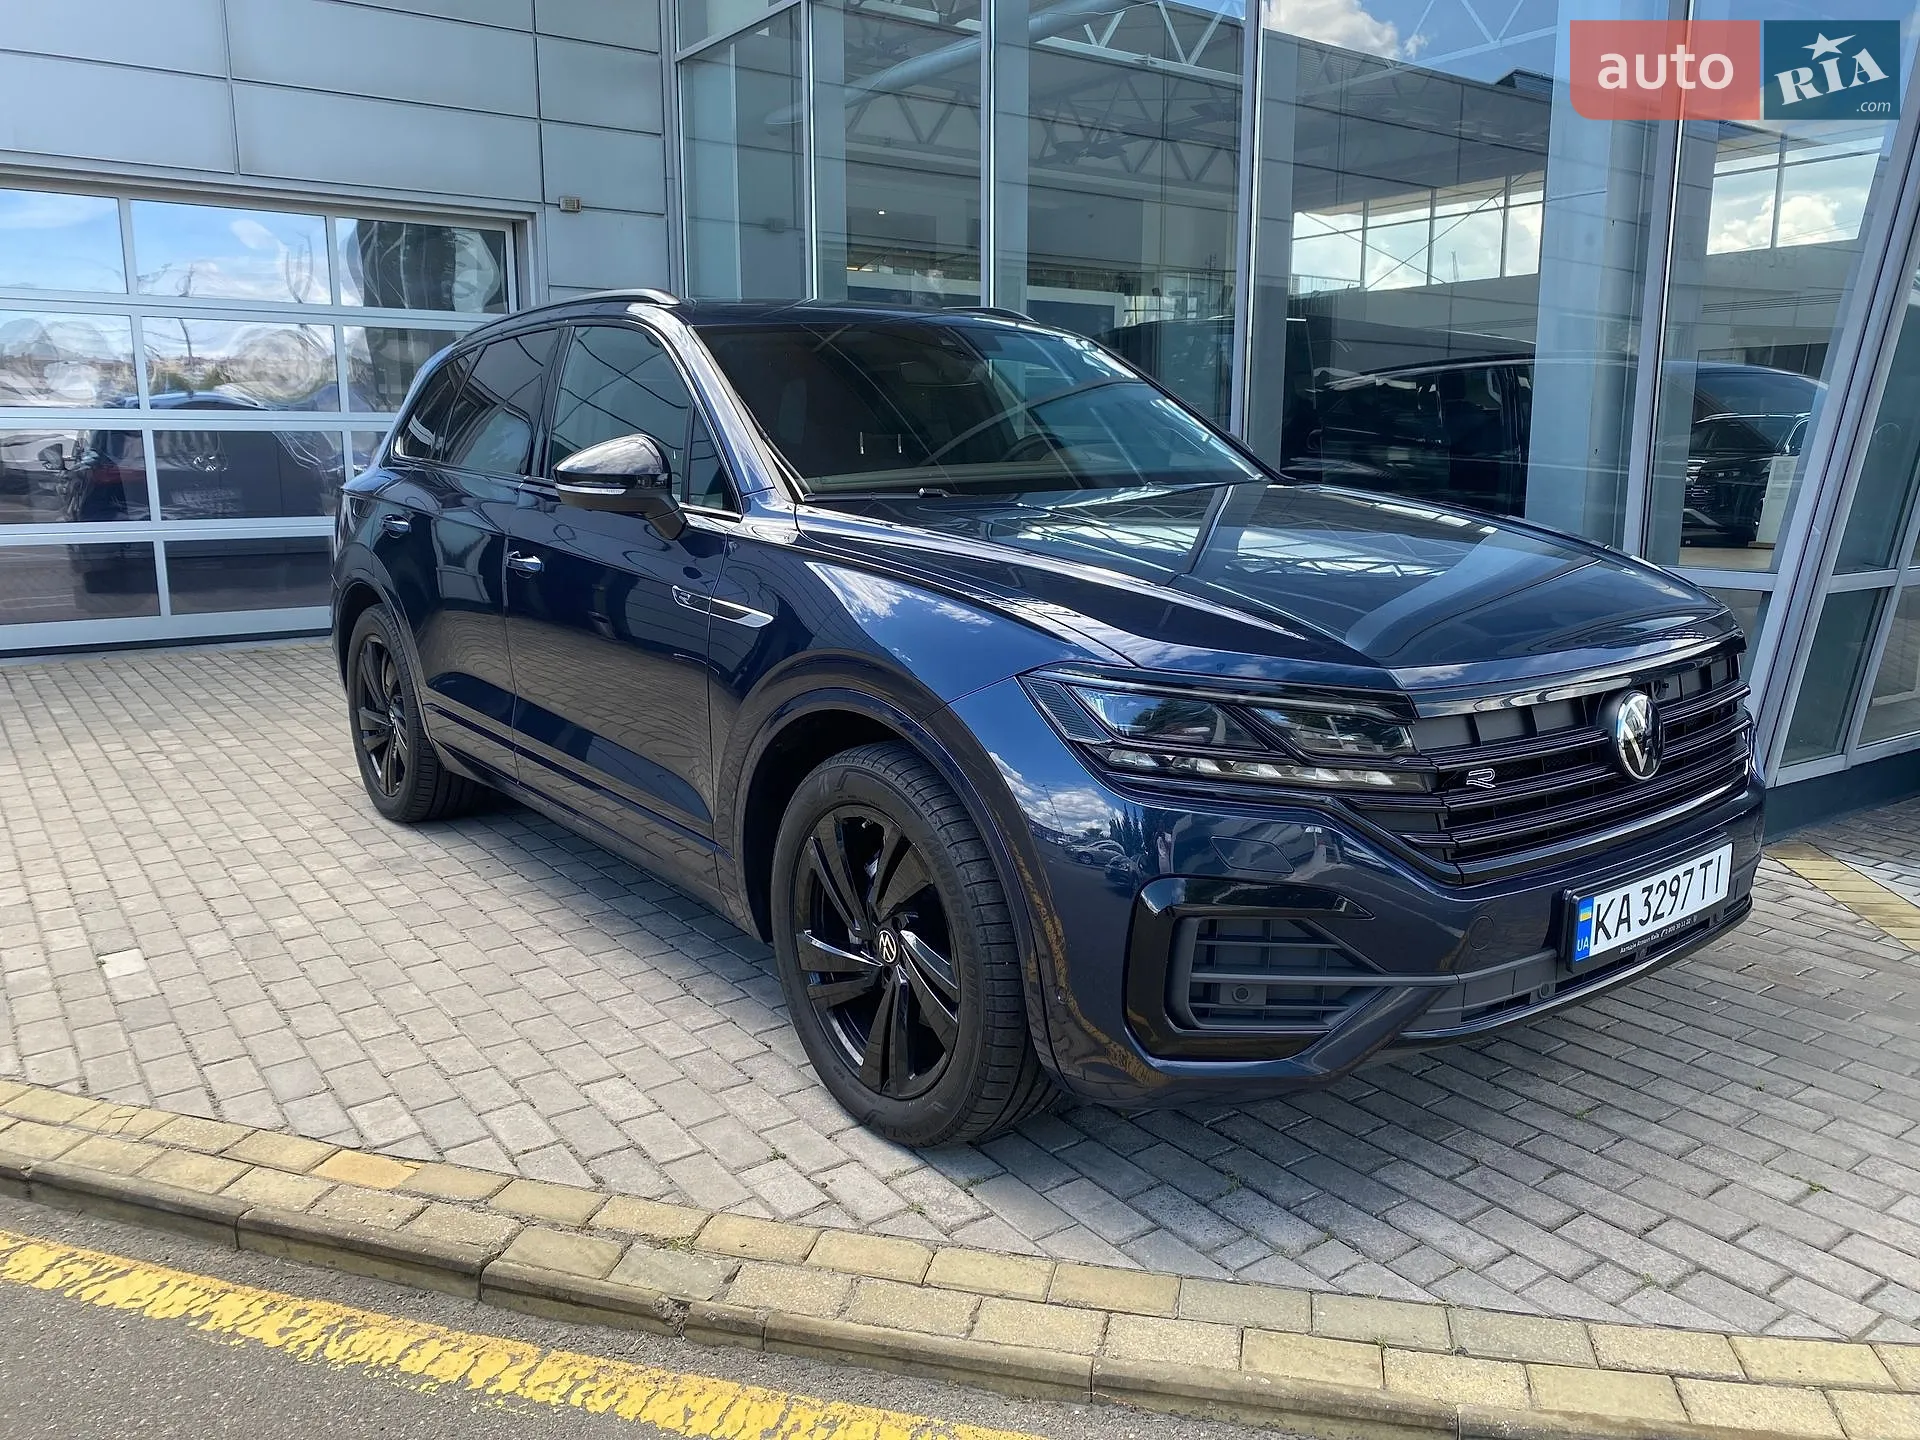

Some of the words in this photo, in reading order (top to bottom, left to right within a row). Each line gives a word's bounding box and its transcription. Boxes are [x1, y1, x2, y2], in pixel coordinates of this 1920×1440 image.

[1593, 892, 1632, 946] KA
[1638, 867, 1695, 927] 3297
[1699, 855, 1723, 901] TI
[1577, 937, 1590, 951] UA
